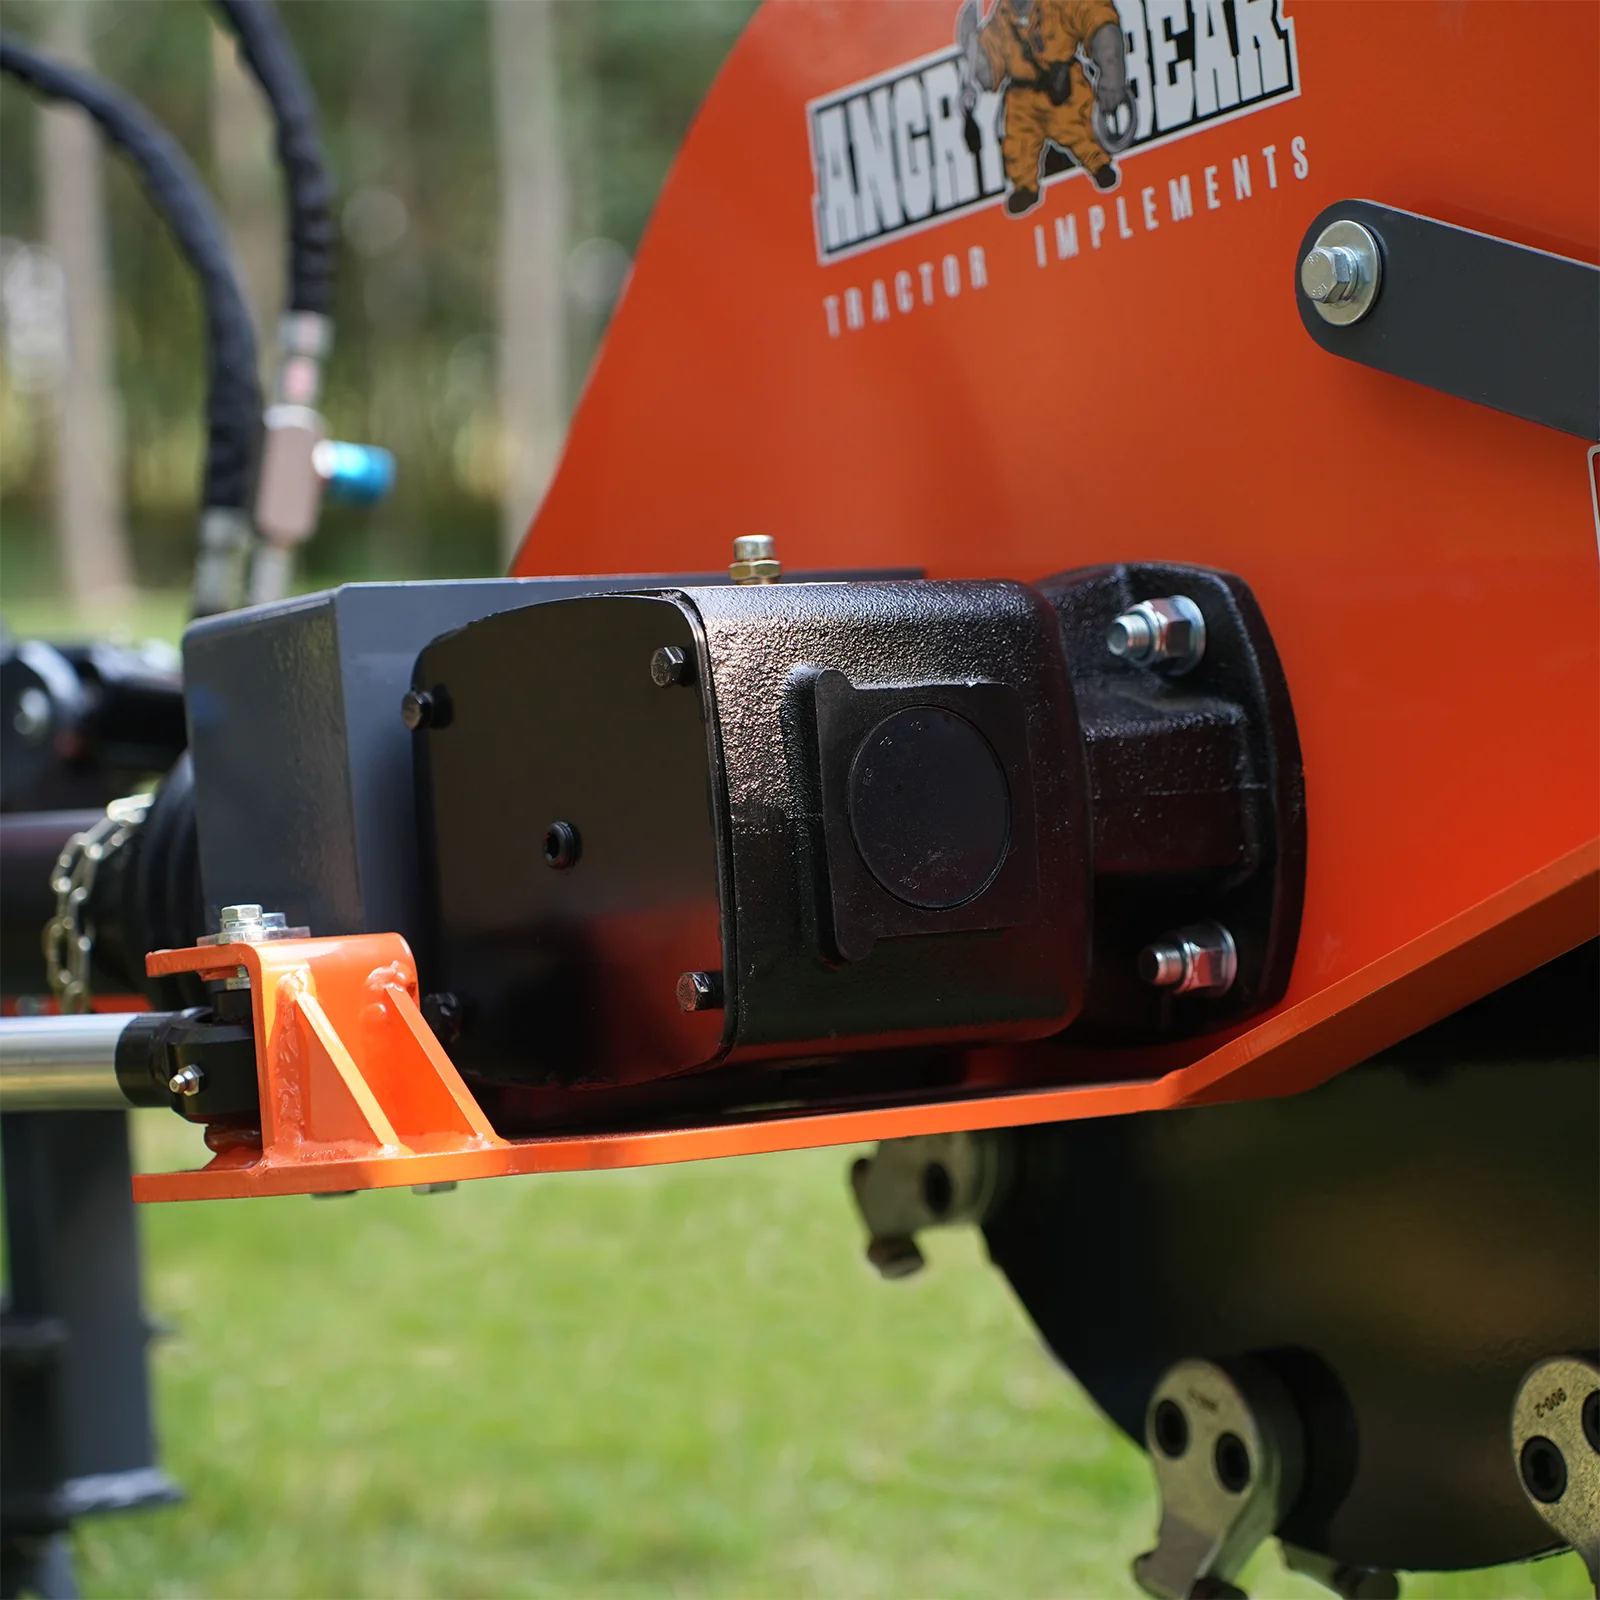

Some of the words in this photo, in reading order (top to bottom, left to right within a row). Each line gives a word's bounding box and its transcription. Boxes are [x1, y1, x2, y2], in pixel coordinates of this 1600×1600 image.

[818, 55, 1006, 252] ANGRY
[1107, 0, 1292, 146] BEAR
[822, 244, 988, 339] TRACTOR
[1033, 135, 1309, 269] IMPLEMENTS
